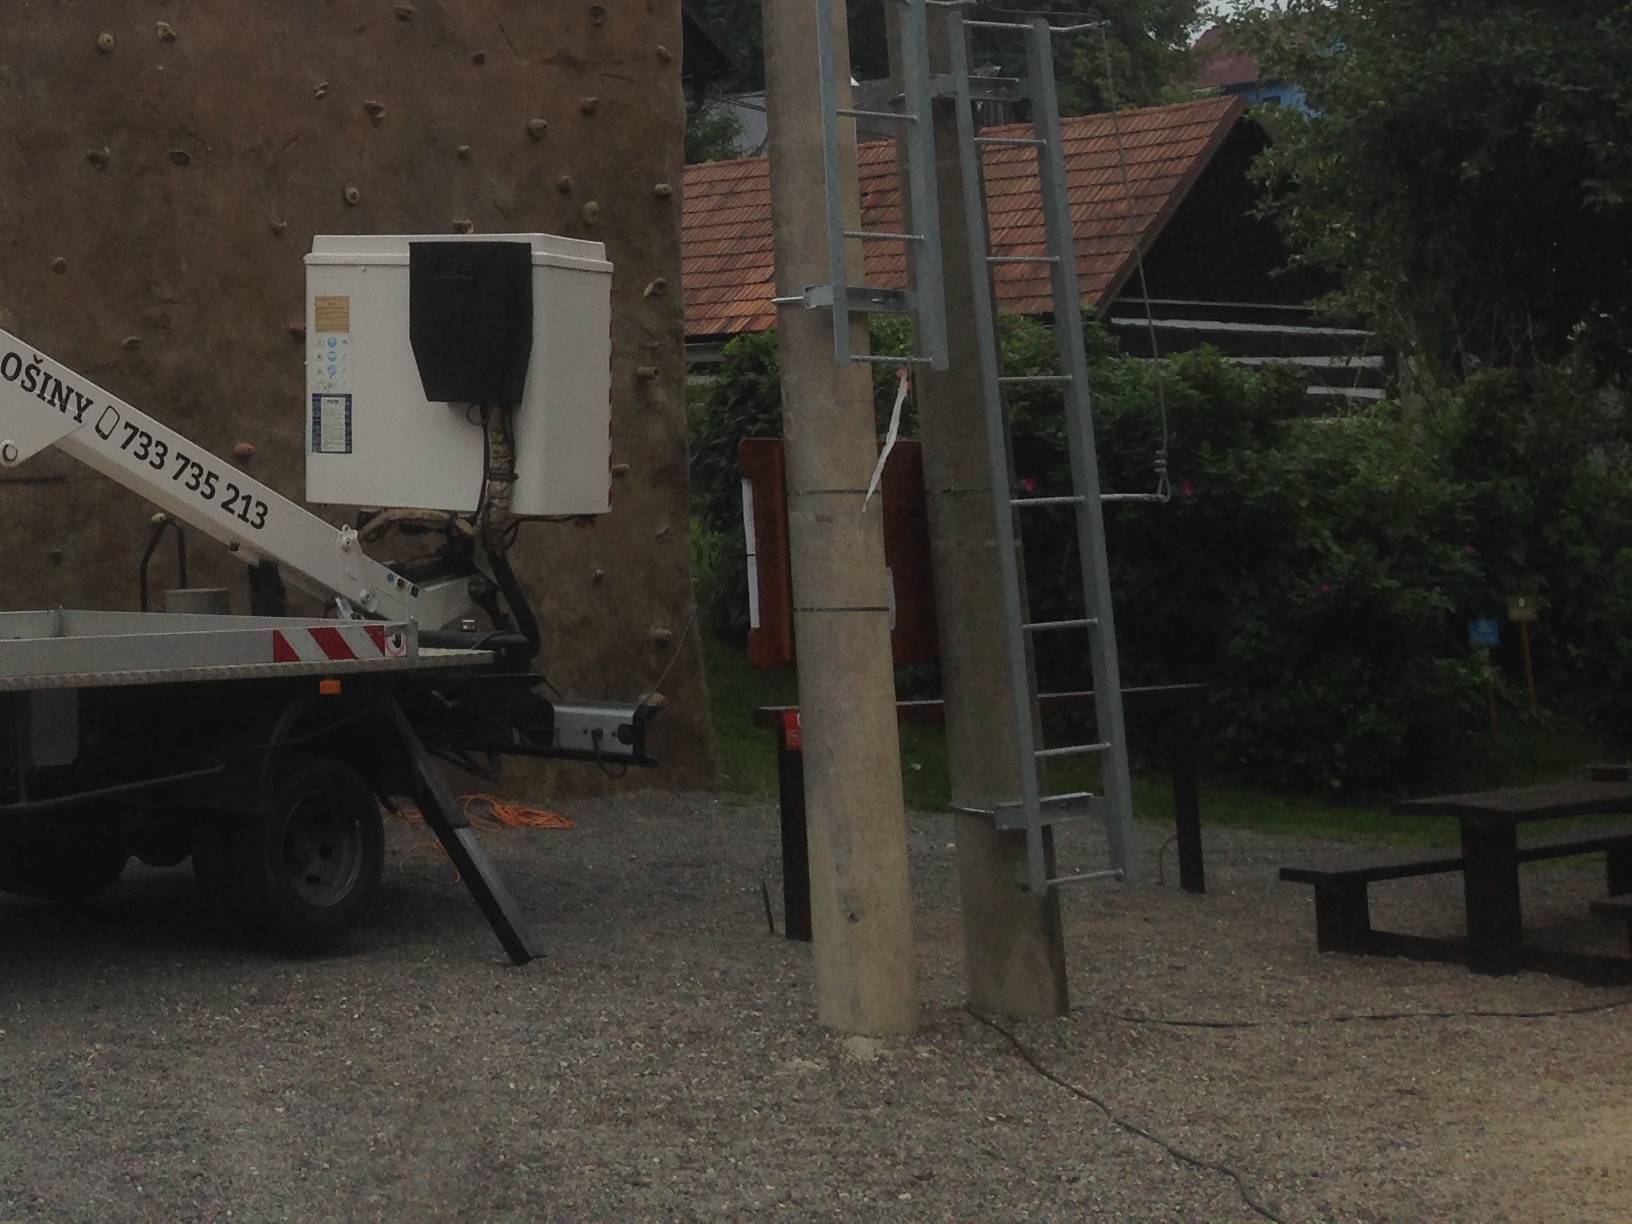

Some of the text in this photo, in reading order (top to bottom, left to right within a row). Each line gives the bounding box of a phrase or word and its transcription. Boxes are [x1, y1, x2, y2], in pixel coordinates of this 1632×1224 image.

[120, 421, 168, 470] 733
[172, 451, 220, 500] 735
[220, 482, 268, 529] 213
